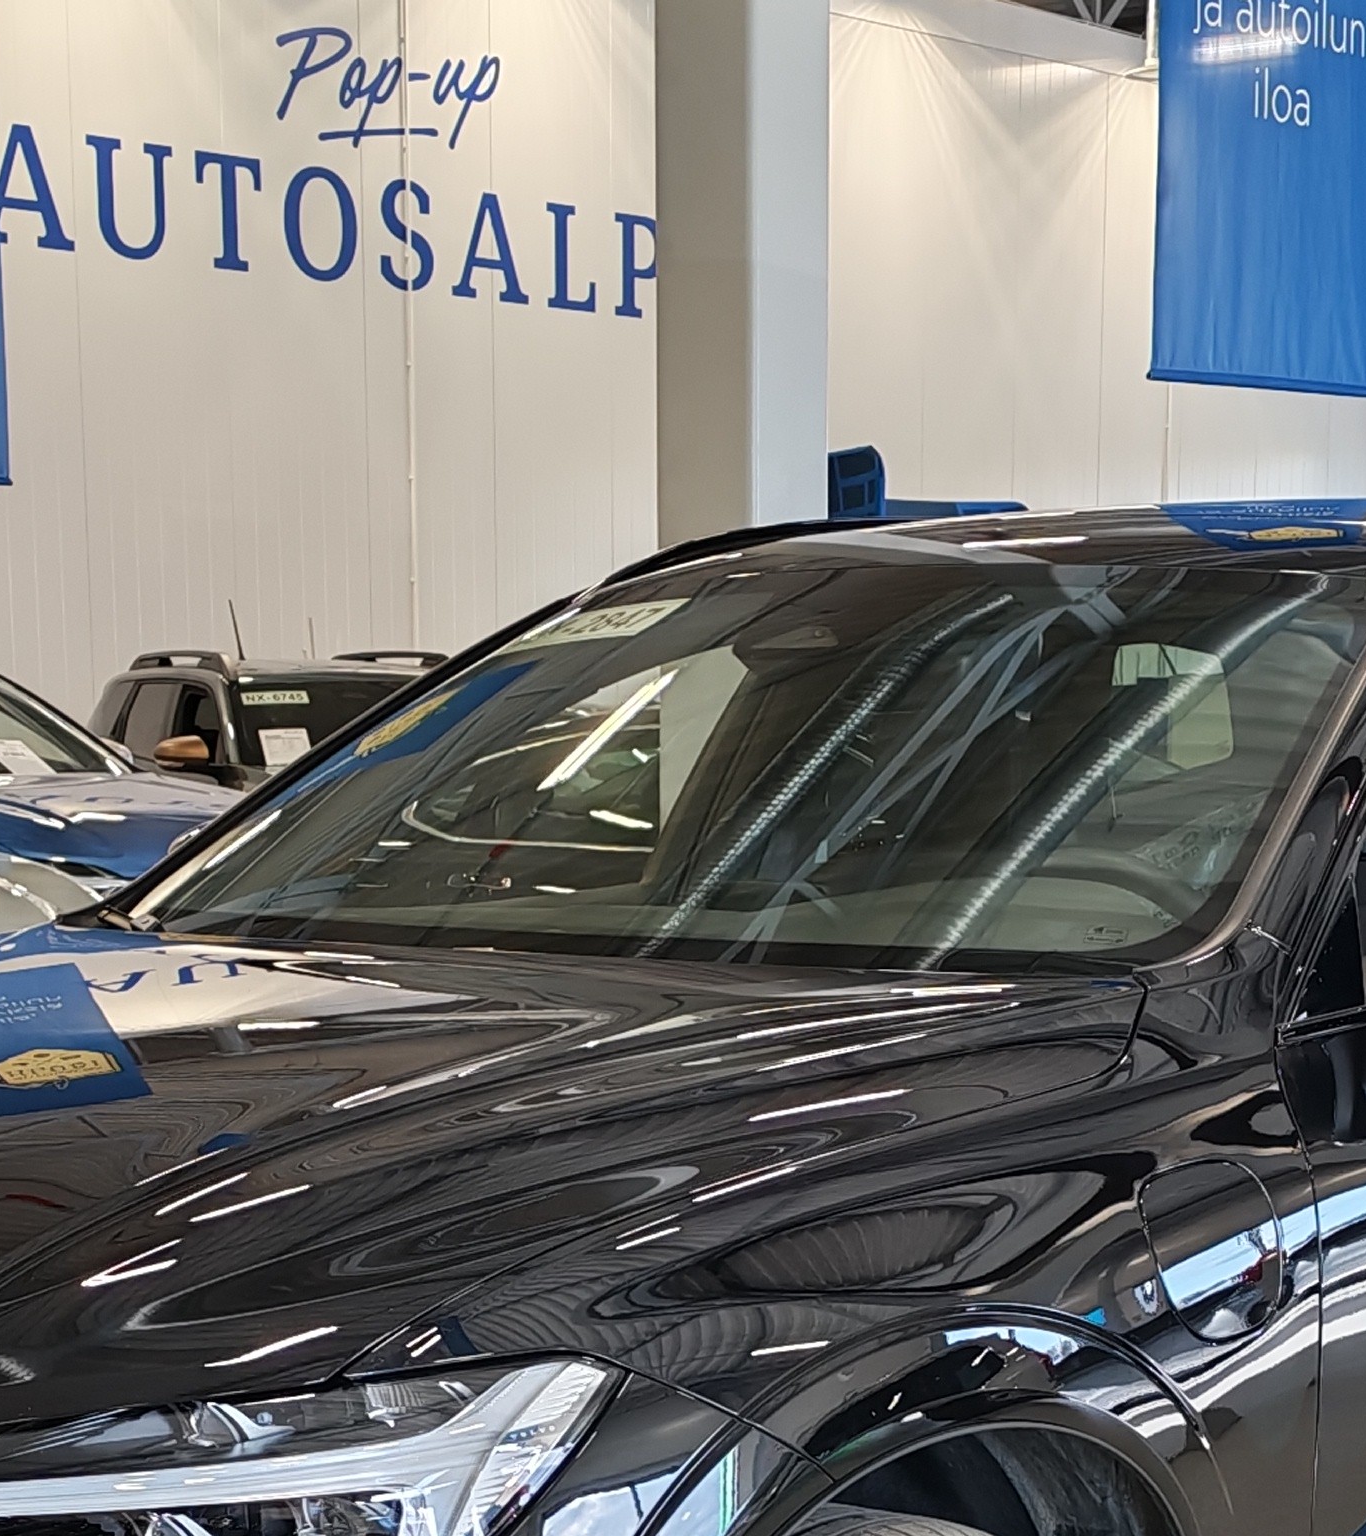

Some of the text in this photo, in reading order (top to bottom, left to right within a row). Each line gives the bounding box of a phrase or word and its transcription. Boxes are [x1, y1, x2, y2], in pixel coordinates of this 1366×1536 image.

[1236, 0, 1366, 58] autoilun
[276, 27, 500, 150] Pop-up
[1254, 66, 1311, 127] iloa
[245, 692, 304, 702] NX-6745
[509, 1425, 556, 1440] VOLVO
